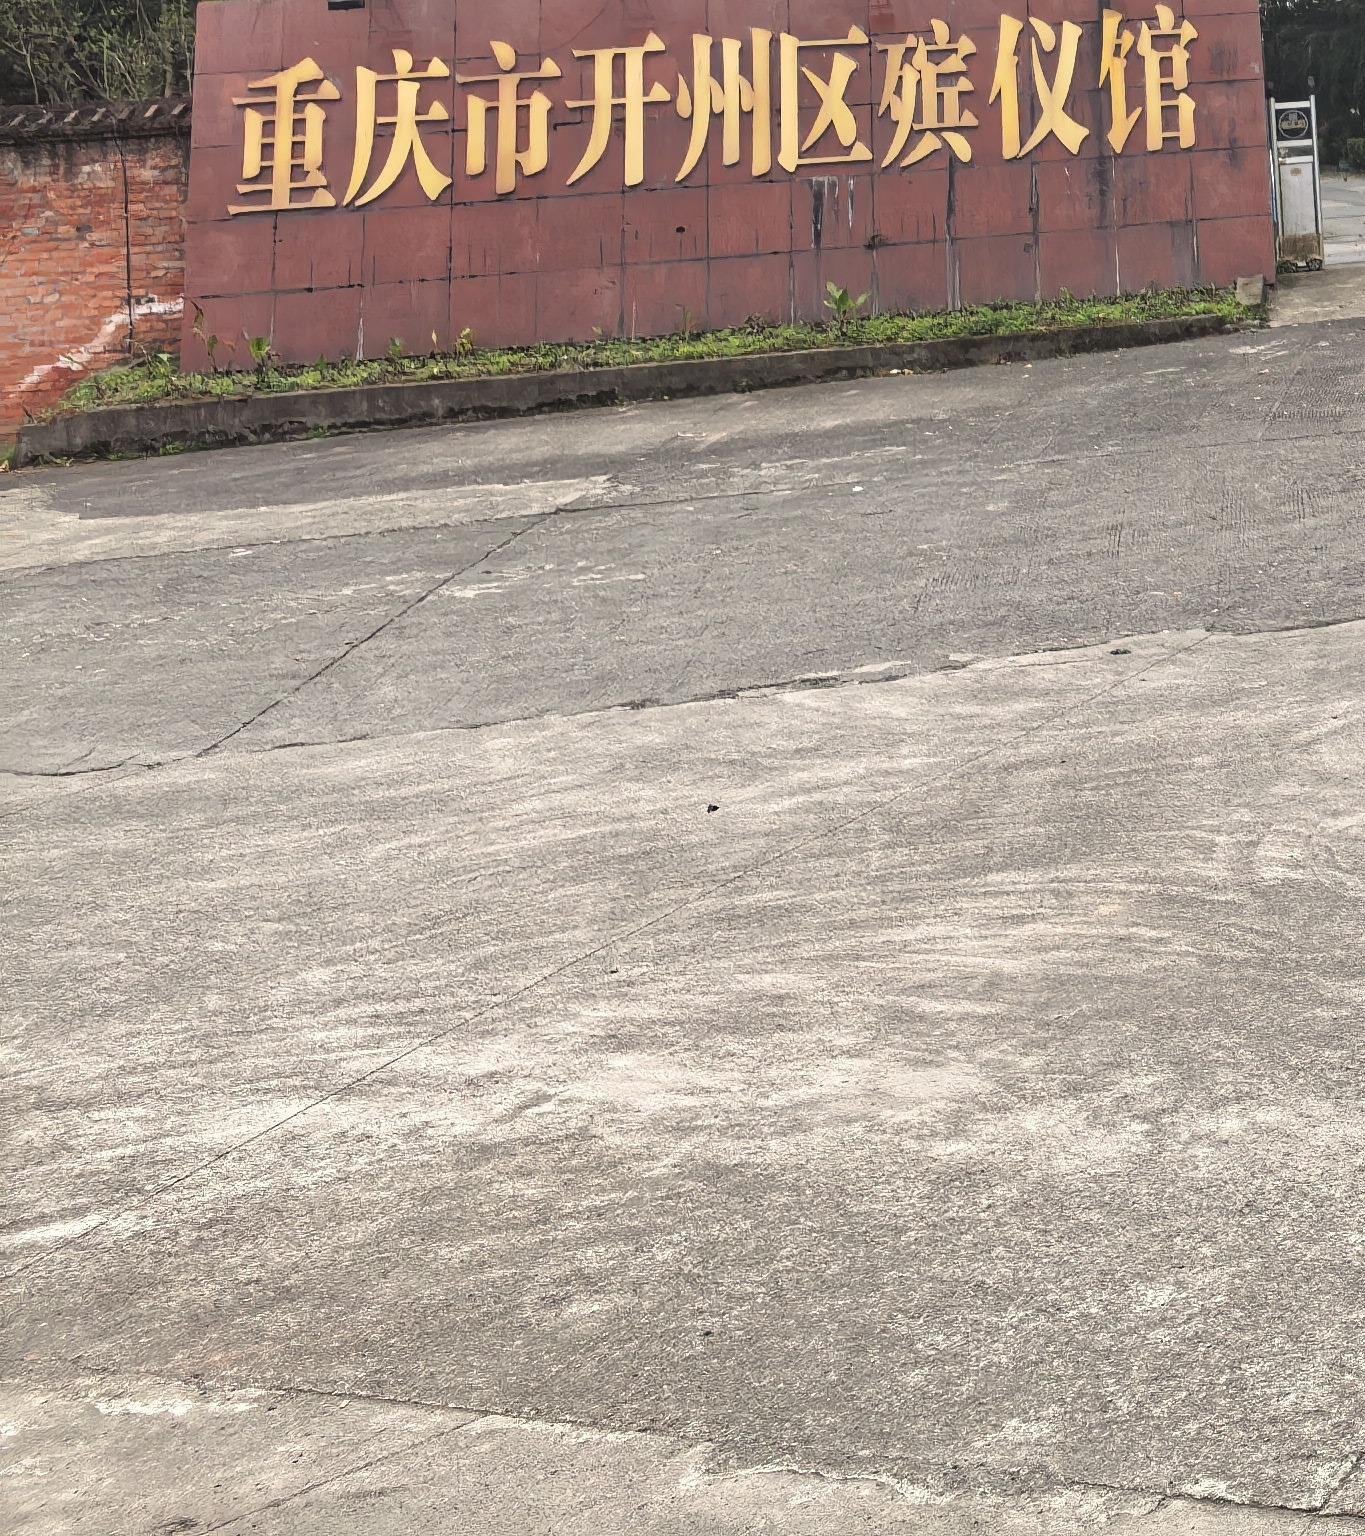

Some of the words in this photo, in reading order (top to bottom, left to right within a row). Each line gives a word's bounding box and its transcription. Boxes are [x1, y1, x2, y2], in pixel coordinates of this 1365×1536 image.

[227, 3, 1199, 216] 重庆市开州区殡仪馆
